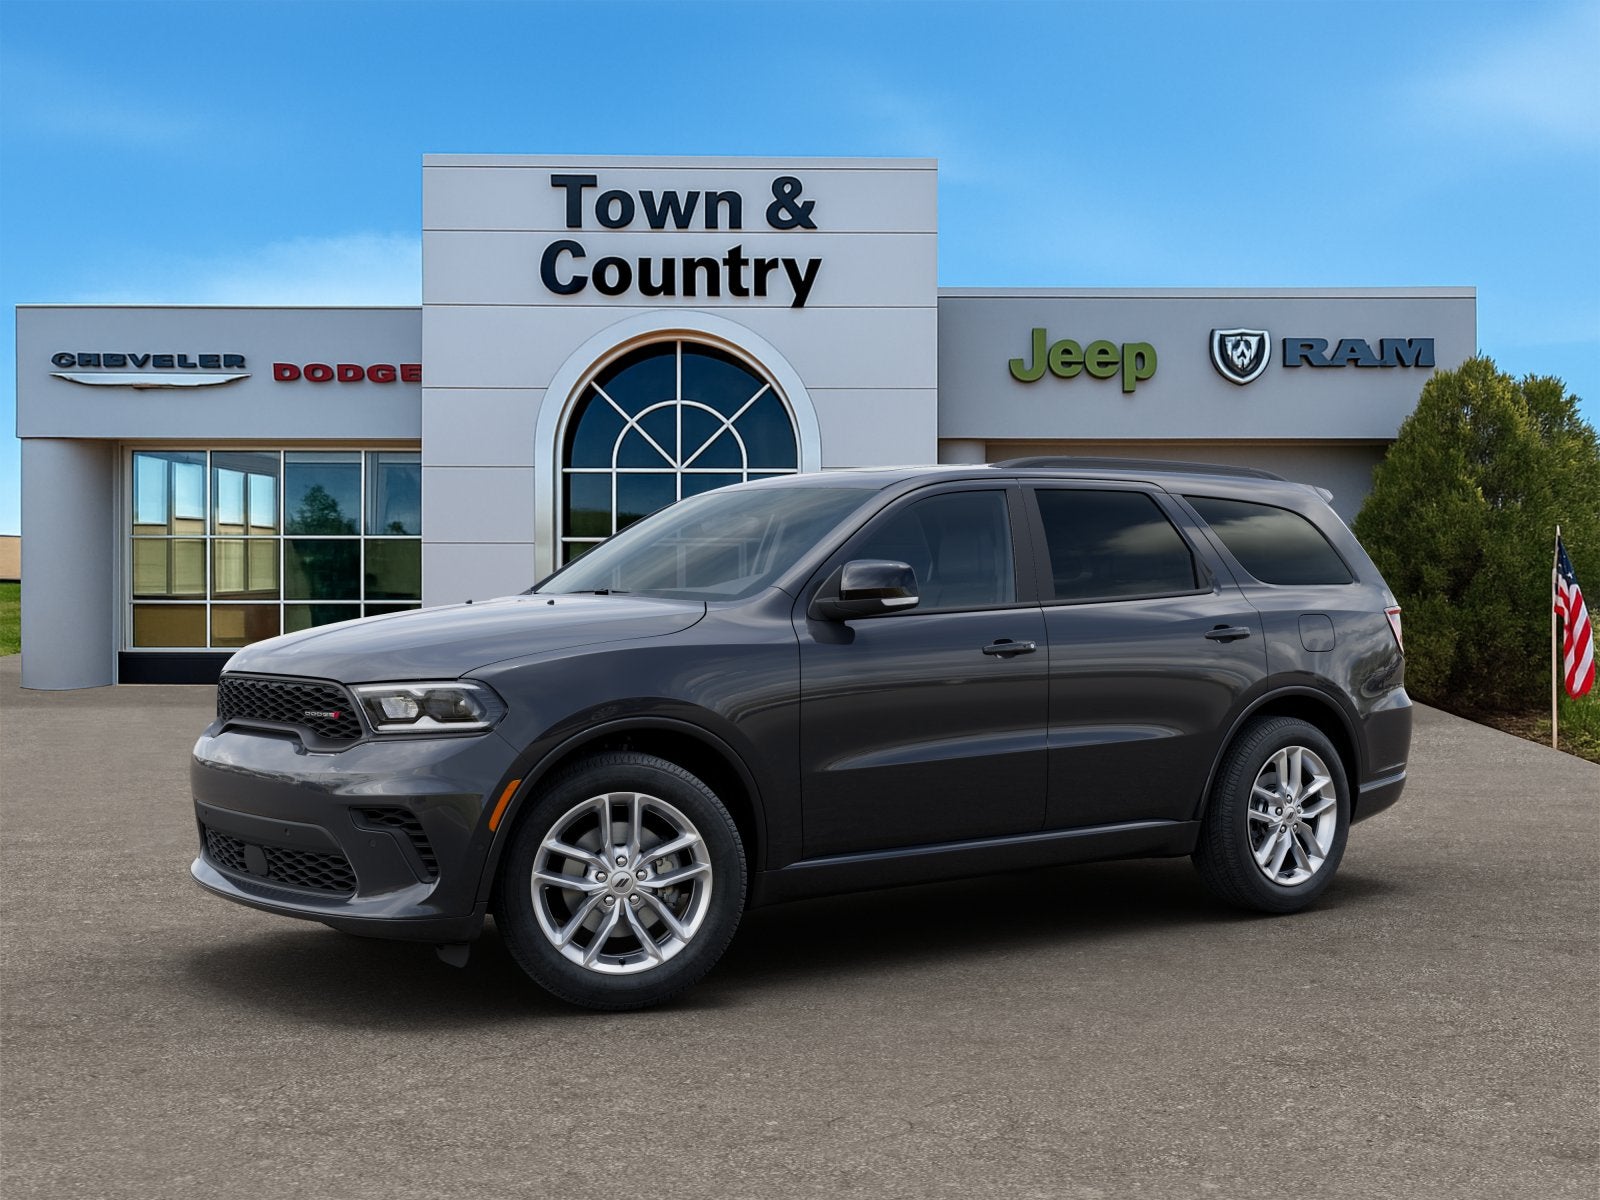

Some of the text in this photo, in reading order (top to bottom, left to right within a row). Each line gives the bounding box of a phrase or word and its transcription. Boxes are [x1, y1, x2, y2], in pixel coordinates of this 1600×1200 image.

[551, 174, 818, 229] Town &
[540, 240, 822, 308] Country
[273, 362, 422, 383] DODGE
[1009, 328, 1157, 393] Jeep
[1282, 337, 1435, 367] RAM
